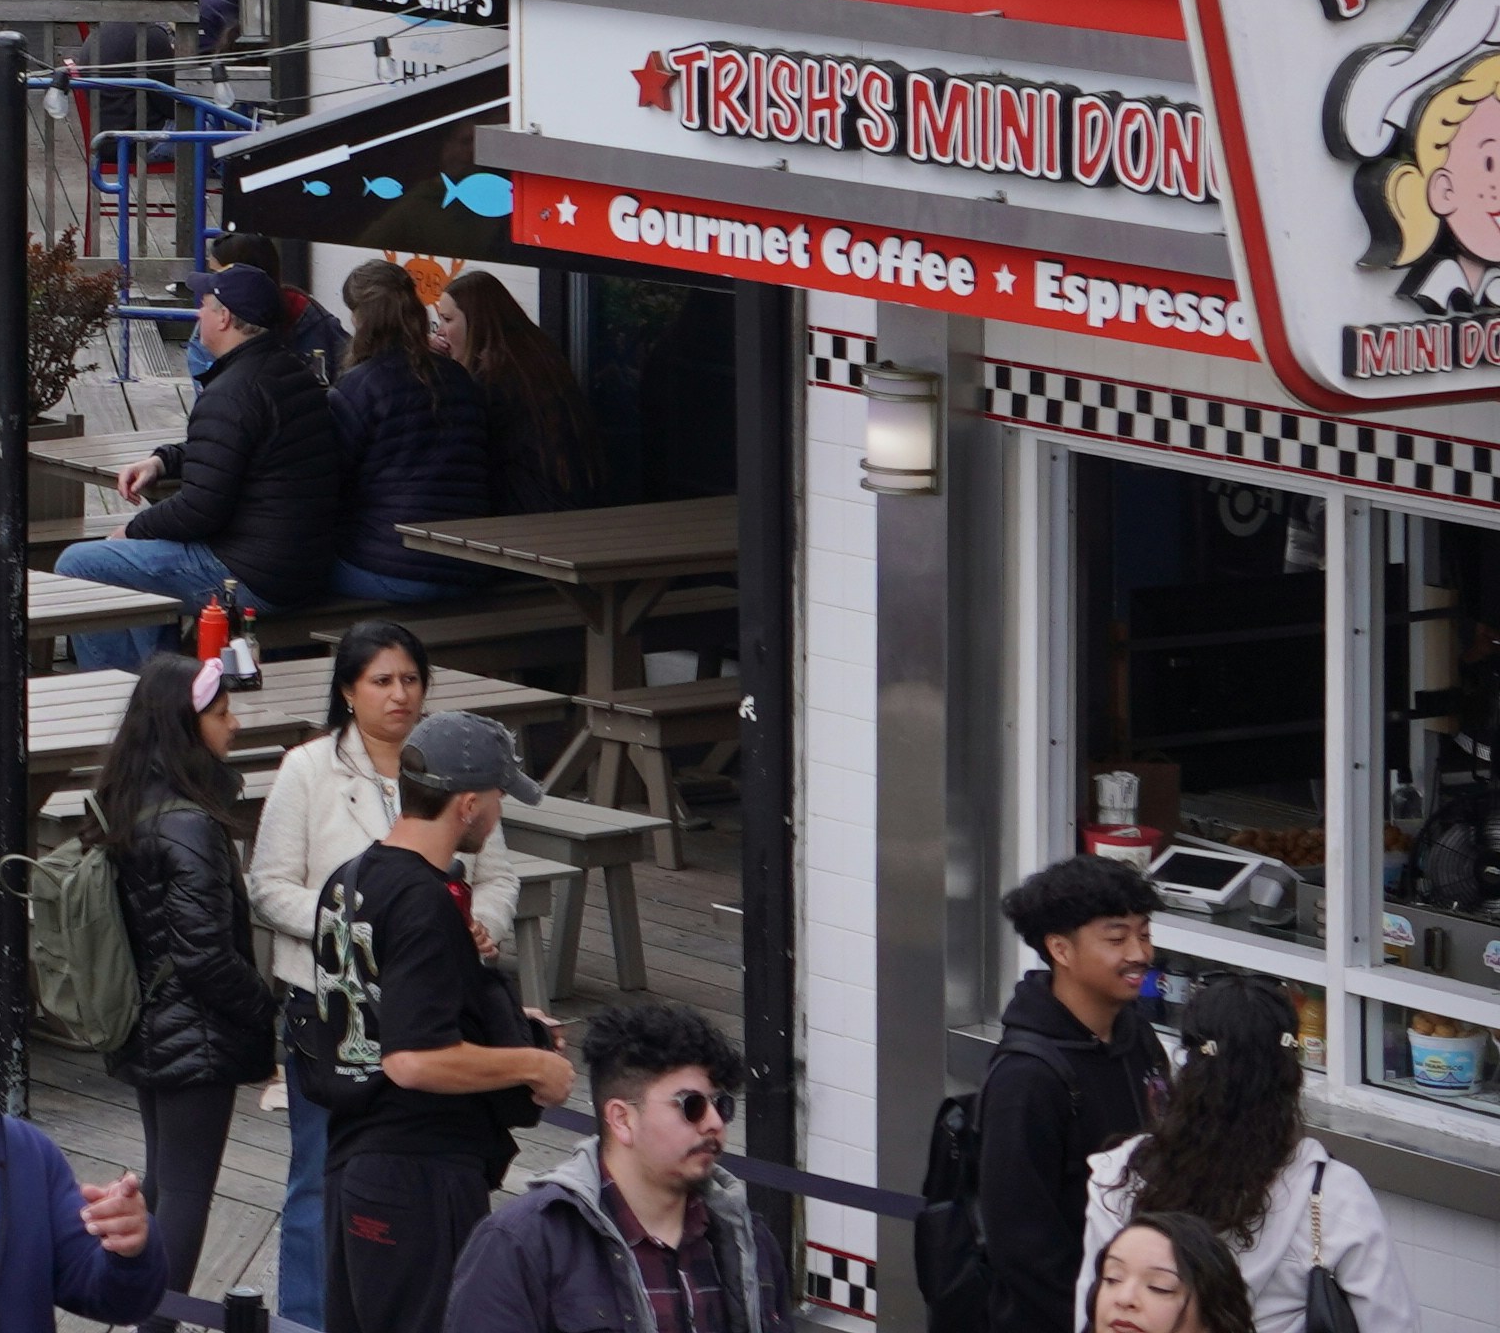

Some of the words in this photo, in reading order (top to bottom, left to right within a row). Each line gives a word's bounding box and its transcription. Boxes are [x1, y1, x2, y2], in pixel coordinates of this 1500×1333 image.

[667, 42, 898, 155] TRISH'S
[906, 70, 1062, 182] MINI
[1071, 91, 1220, 202] DON
[607, 194, 812, 269] Gourmet
[820, 226, 976, 298] Coffee
[1034, 259, 1250, 342] Espresso
[1356, 321, 1453, 380] MINI
